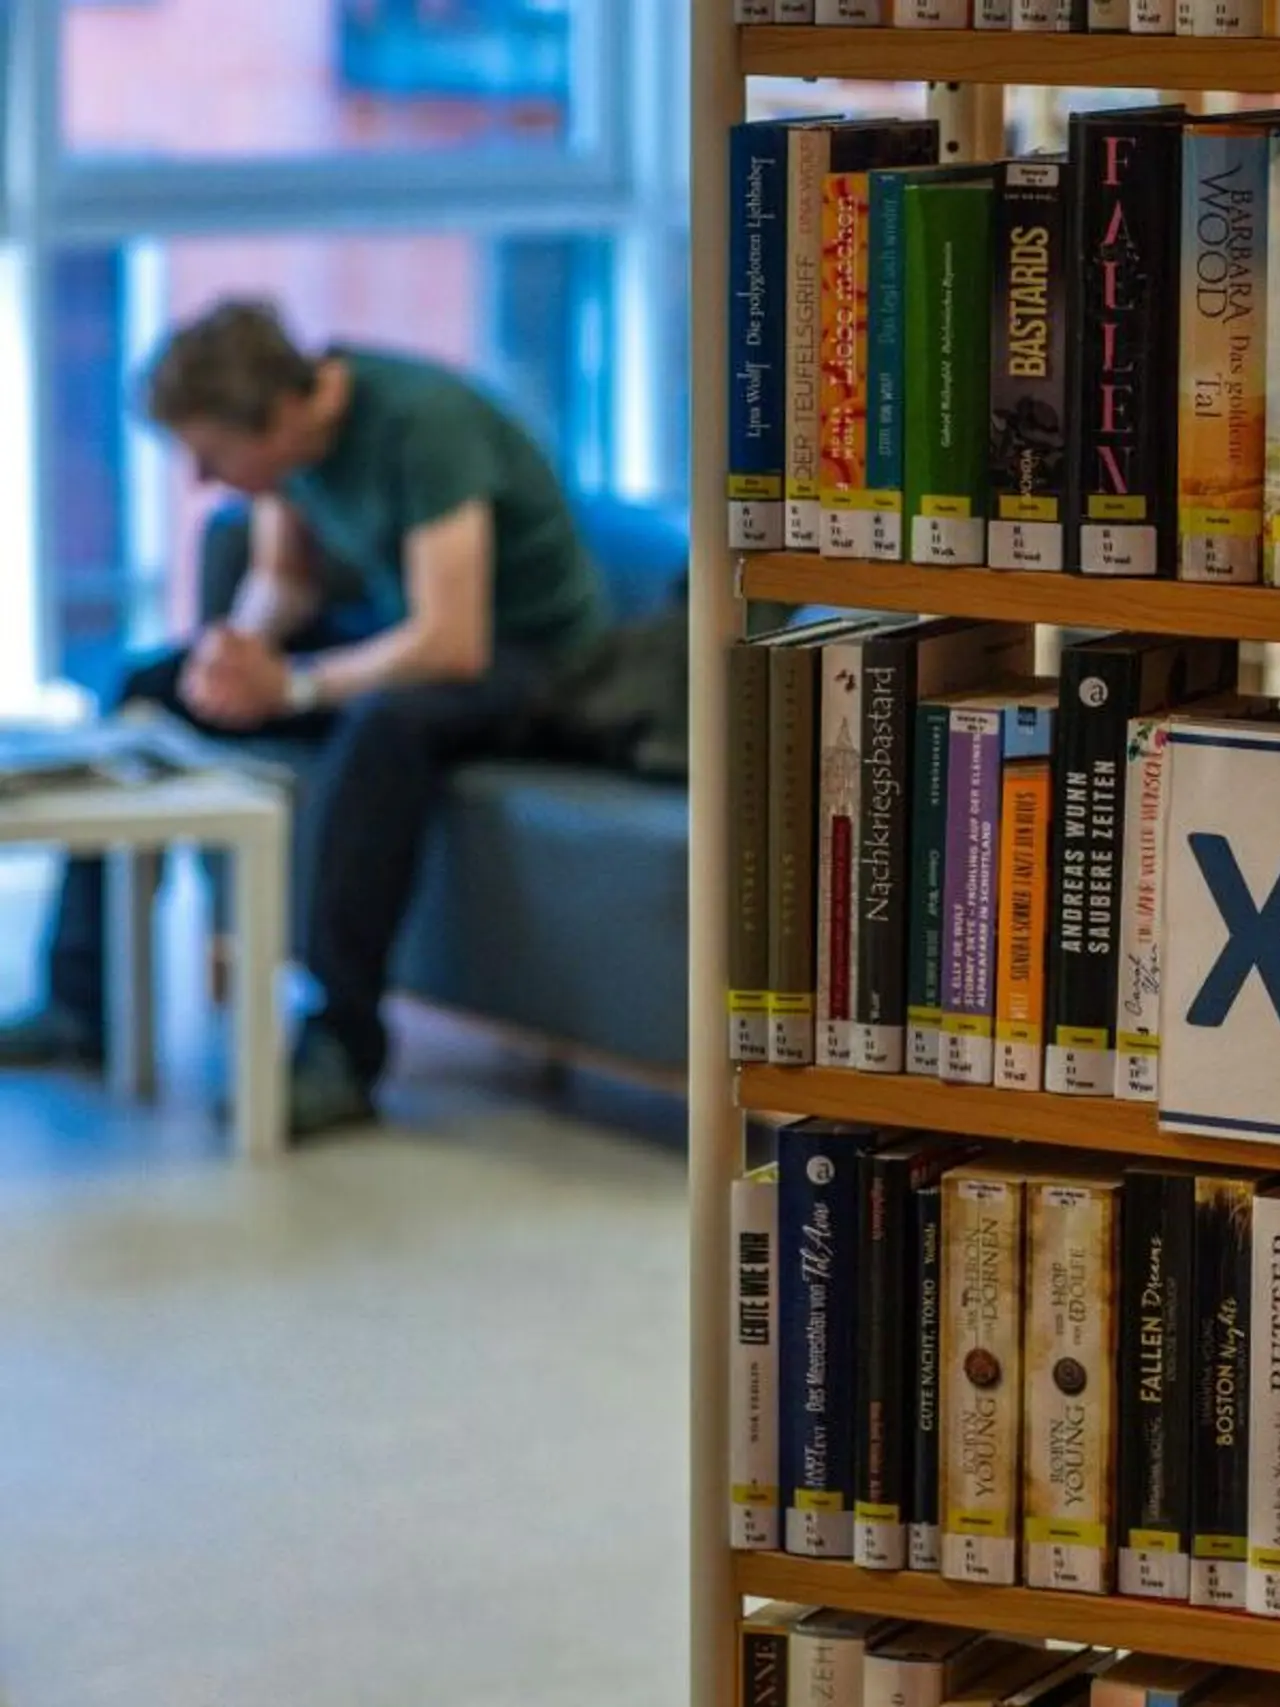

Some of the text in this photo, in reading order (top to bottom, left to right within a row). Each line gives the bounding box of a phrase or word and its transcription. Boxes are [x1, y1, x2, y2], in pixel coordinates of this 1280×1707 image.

[736, 234, 765, 316] polyglotten
[832, 194, 854, 300] machen
[1196, 163, 1243, 320] WOOD
[1222, 190, 1253, 325] BARBARA
[748, 320, 761, 345] Die
[794, 255, 816, 432] TEUFELSGRIFF
[830, 307, 853, 386] Liebe
[1009, 226, 1048, 377] BASTARDS
[1194, 373, 1221, 418] Tal
[1229, 335, 1249, 365] Das
[864, 667, 899, 923] Nachkriegsbastard
[1061, 770, 1088, 953] ANDREAS WUNN
[1089, 760, 1116, 954] SAUBERE ZEITEN
[807, 1284, 826, 1309] von
[982, 1217, 1000, 1320] DORNEN
[1141, 1233, 1163, 1309] Dreams
[805, 1388, 826, 1412] Das
[1140, 1316, 1162, 1403] FALLEN
[1216, 1364, 1236, 1446] BOSTON
[920, 1389, 935, 1431] GUTE
[975, 1397, 999, 1499] YOUNG
[1064, 1404, 1086, 1508] YOUNG
